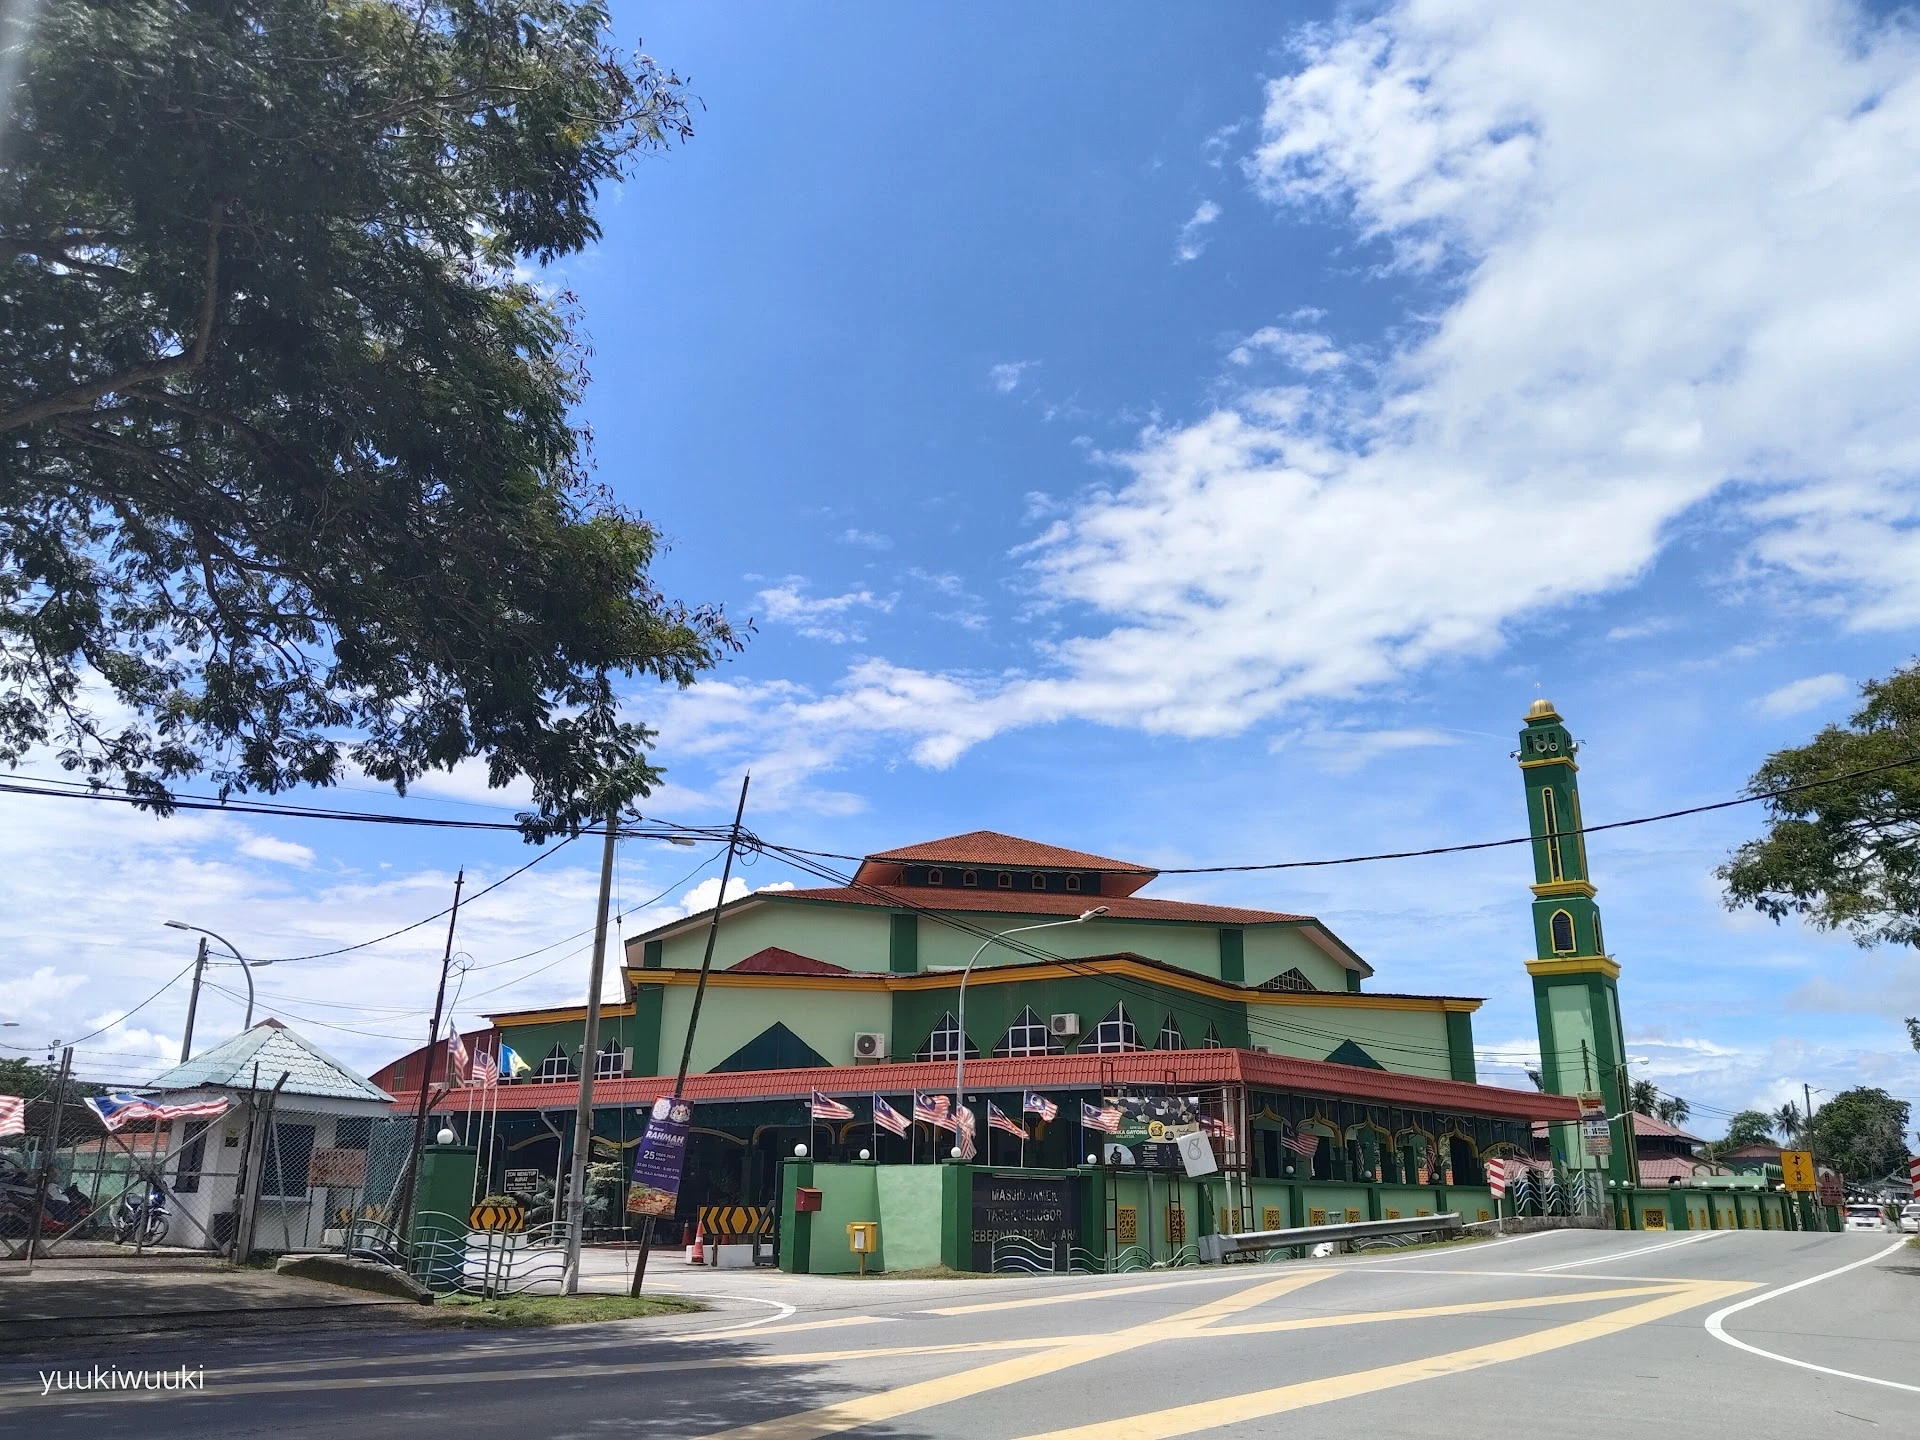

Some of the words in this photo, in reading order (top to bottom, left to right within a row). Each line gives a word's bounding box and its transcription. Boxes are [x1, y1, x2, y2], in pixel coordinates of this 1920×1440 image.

[645, 1130, 685, 1143] RAHMAH
[643, 1150, 655, 1160] 25
[991, 1189, 1025, 1201] MASJID
